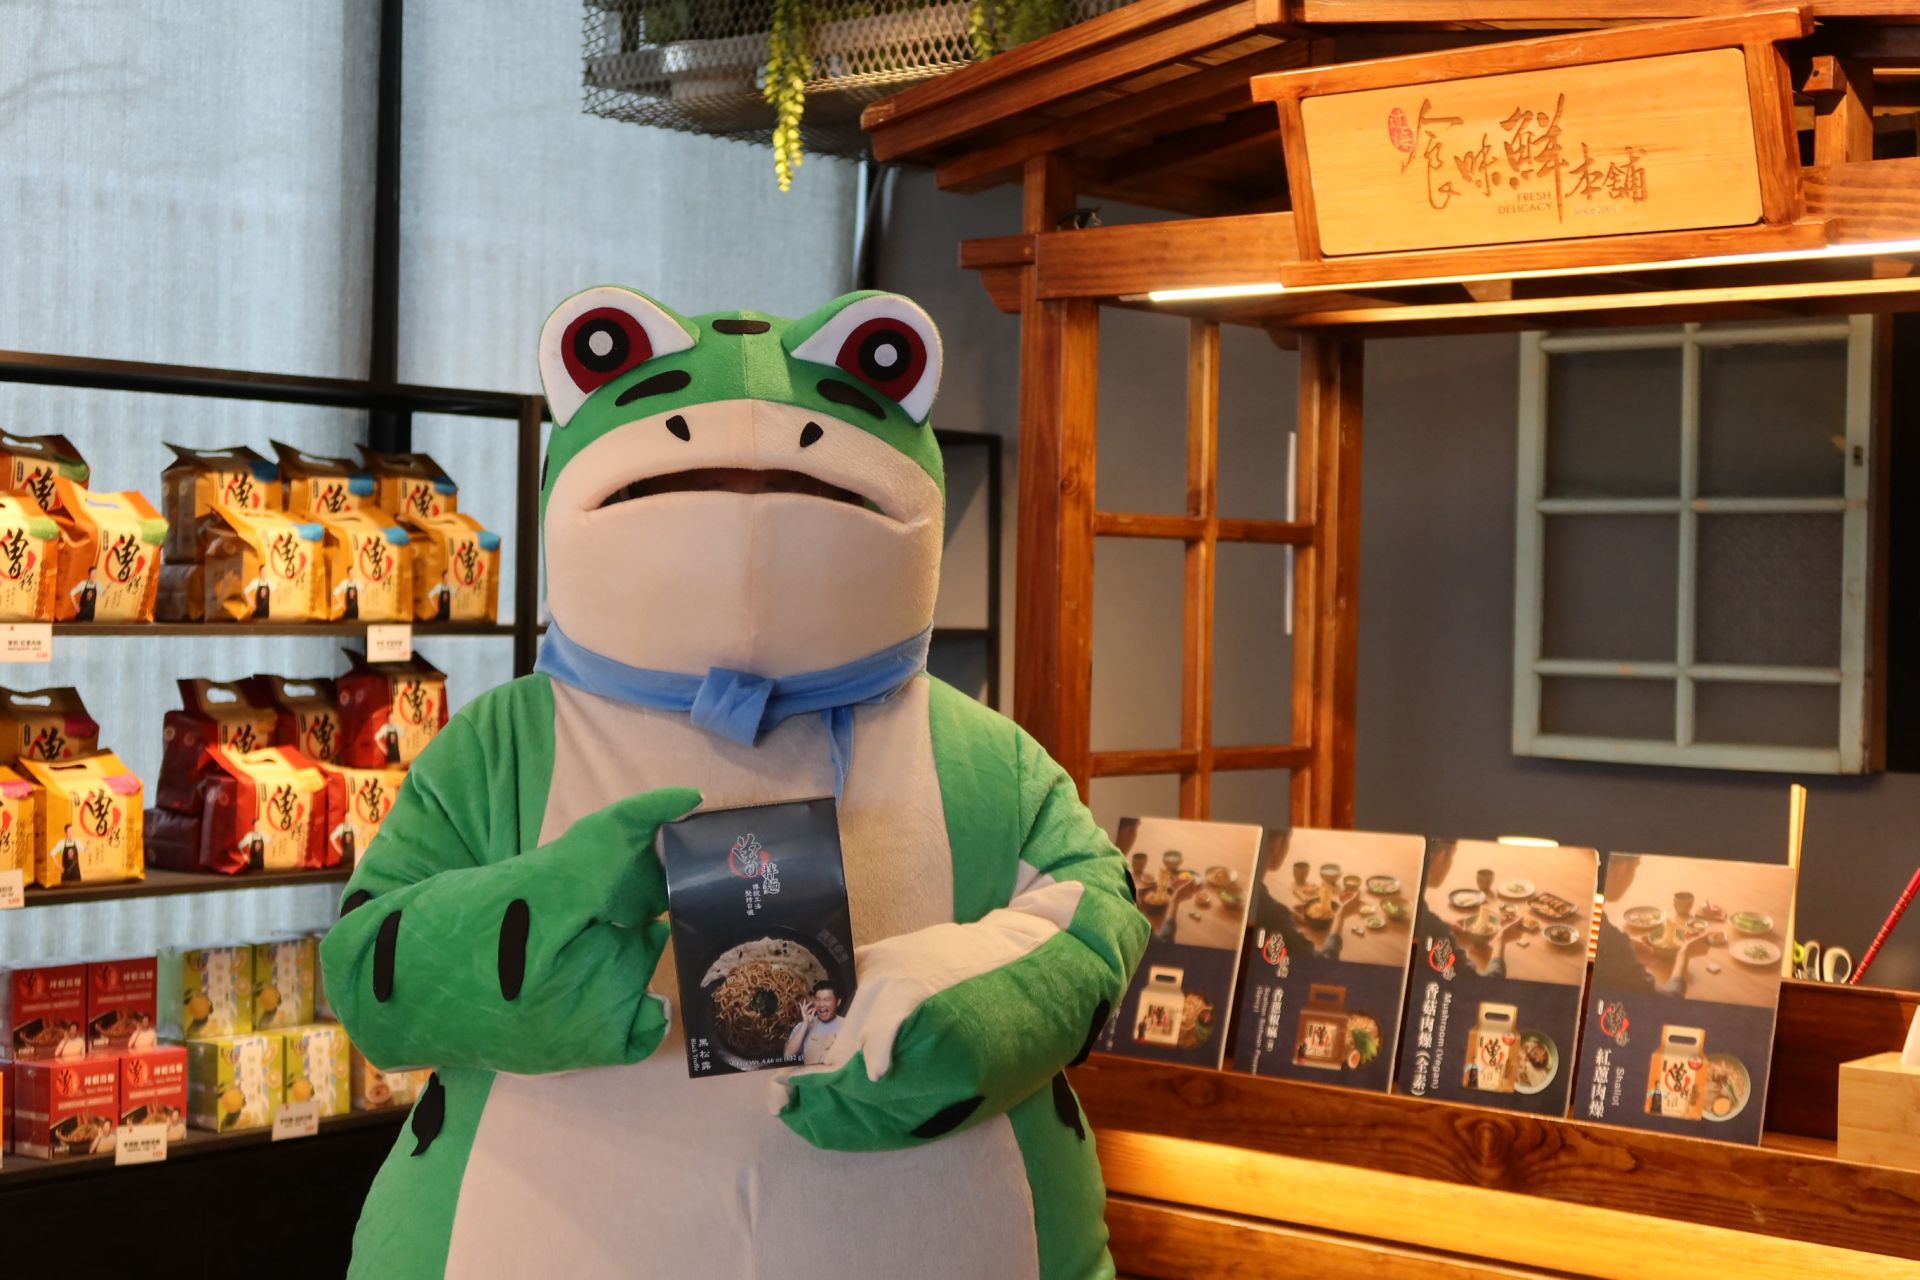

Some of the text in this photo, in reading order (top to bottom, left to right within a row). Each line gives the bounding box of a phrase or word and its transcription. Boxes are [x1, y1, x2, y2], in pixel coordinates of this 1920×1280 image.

[1497, 201, 1552, 215] DELICACY
[1517, 191, 1552, 202] FRESH
[690, 1038, 700, 1072] Black Truffle
[698, 1038, 712, 1071] 黑松露
[1430, 991, 1452, 1090] Mushroom (Vegan)
[1611, 1067, 1625, 1107] Shallot
